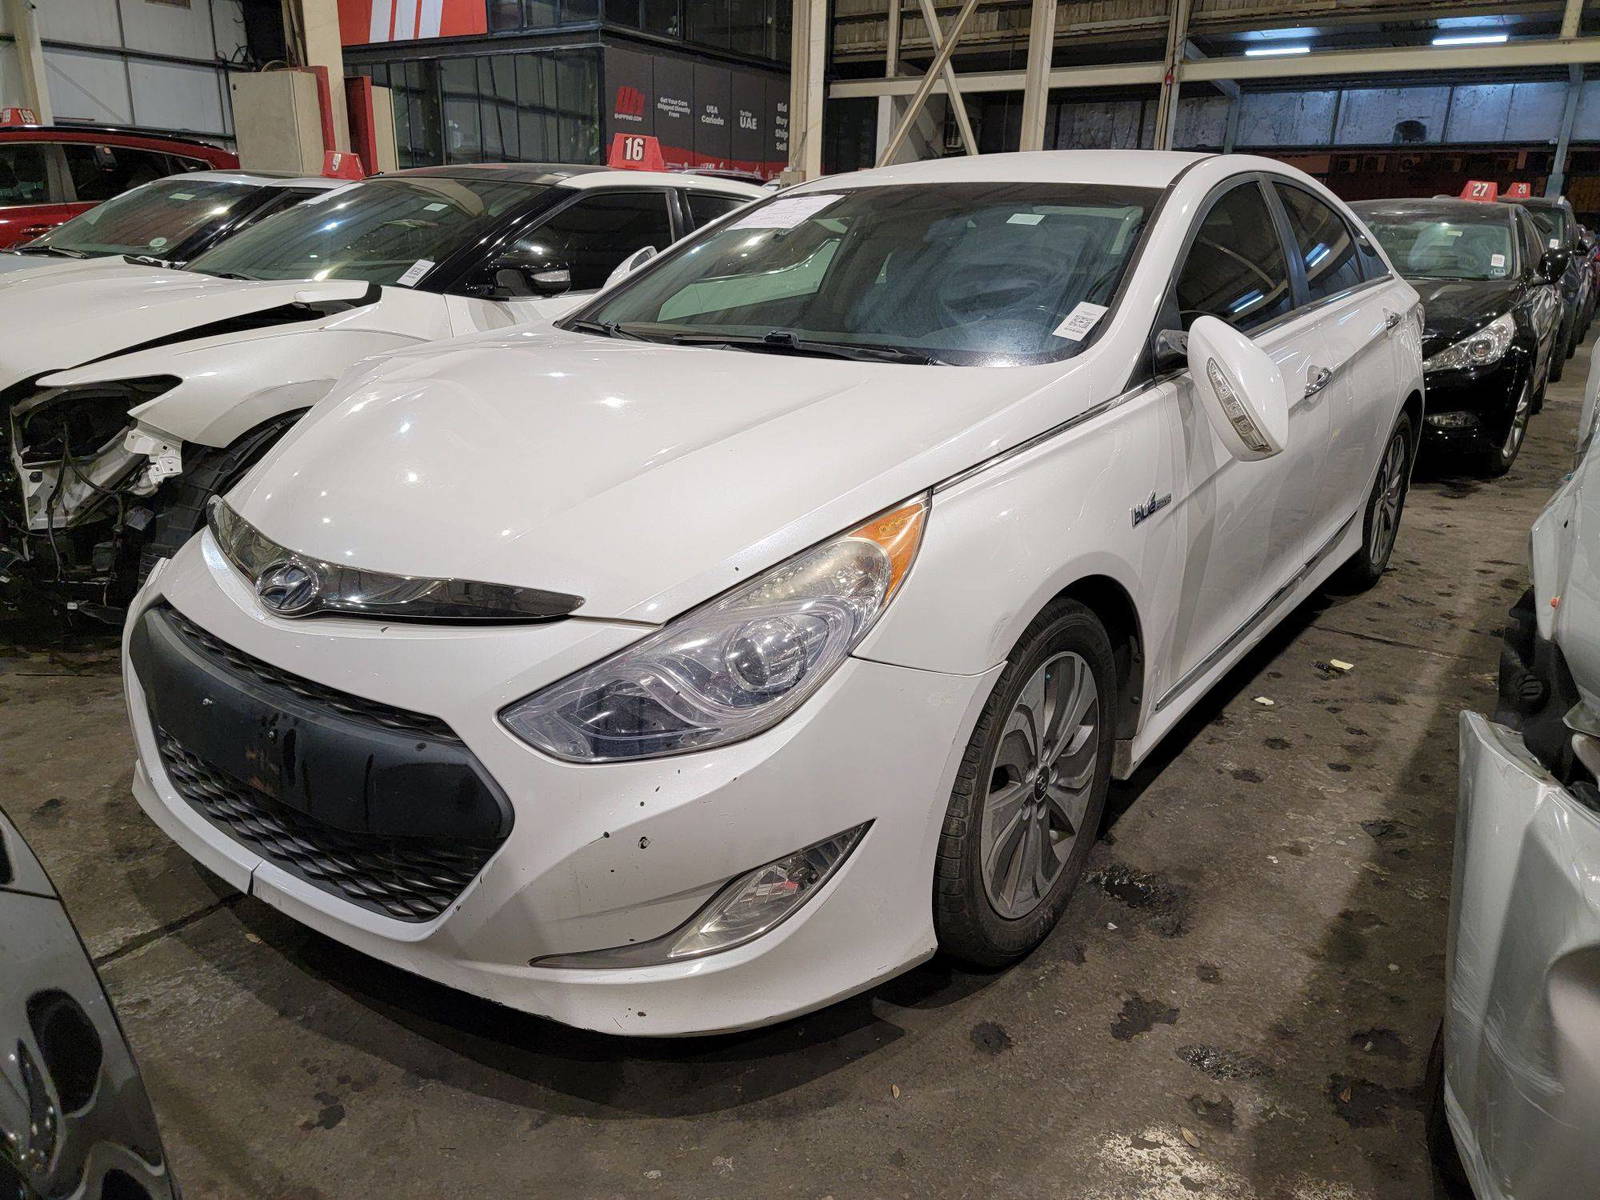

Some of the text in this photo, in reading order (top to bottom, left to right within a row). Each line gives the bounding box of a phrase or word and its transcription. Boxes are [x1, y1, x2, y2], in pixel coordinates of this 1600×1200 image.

[706, 104, 719, 114] USA
[701, 115, 725, 126] Canada
[740, 116, 758, 130] UAE
[775, 128, 788, 141] Ship
[625, 137, 644, 161] 16
[775, 142, 787, 151] Sell
[1472, 183, 1489, 197] 27
